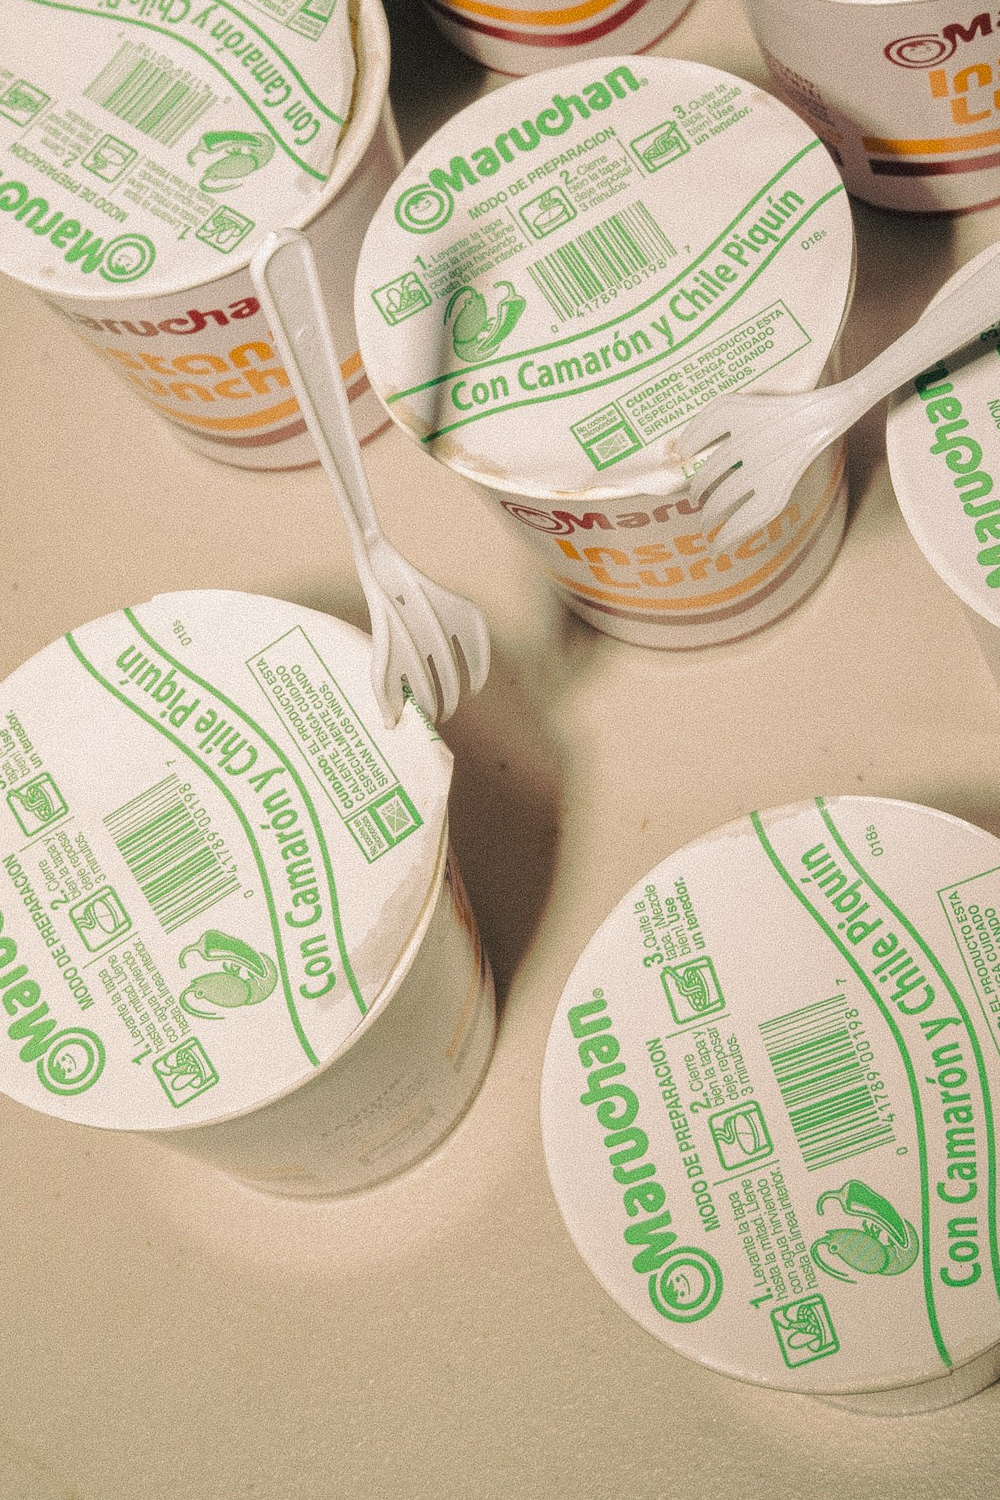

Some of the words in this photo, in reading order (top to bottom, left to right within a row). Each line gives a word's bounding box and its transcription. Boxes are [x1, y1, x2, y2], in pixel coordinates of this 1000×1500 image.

[190, 1, 221, 30] y
[210, 17, 292, 107] Camarón
[281, 100, 324, 149] Con
[429, 67, 640, 202] Maruchan
[467, 189, 509, 220] MODO
[506, 177, 529, 197] DE
[526, 125, 617, 184] PREPARACION
[0, 181, 103, 274] Maruc
[71, 296, 261, 337] arucha
[450, 376, 511, 412] Con
[517, 330, 652, 393] Camarón
[649, 315, 675, 348] y
[668, 264, 737, 322] Chile
[721, 191, 805, 267] Piquín
[127, 366, 292, 402] unch
[118, 647, 201, 728] Piquín
[194, 708, 259, 777] Chile
[247, 765, 288, 794] y
[261, 789, 323, 929] Camarón
[0, 853, 60, 948] PREPARACION
[663, 895, 681, 924] Use
[672, 876, 700, 931] tenedor.
[800, 843, 882, 944] Piquín
[947, 890, 968, 924] ESTA
[674, 928, 692, 955] bien!
[690, 930, 706, 950] un
[967, 903, 998, 963] CUIDADO
[49, 943, 73, 969] DE
[298, 933, 338, 1001] Con
[871, 932, 935, 1015] Chile
[960, 923, 995, 994] PRODUCTO
[61, 964, 95, 1011] MODO
[693, 1029, 705, 1039] y
[842, 1006, 874, 1064] 00198
[918, 1015, 963, 1040] y
[694, 1038, 712, 1066] tapa
[706, 1026, 729, 1072] reposar
[726, 1034, 748, 1084] minutos.
[683, 1053, 703, 1092] Cierre
[704, 1065, 716, 1079] la
[722, 1074, 740, 1101] deje
[740, 1085, 753, 1096] 3
[644, 1036, 694, 1152] PREPARACION
[687, 1090, 712, 1114] 2.
[709, 1080, 725, 1107] bien
[866, 1070, 895, 1127] 41789
[568, 999, 686, 1272] Maruchan
[925, 1042, 978, 1204] Camarón
[681, 1152, 704, 1179] DE
[689, 1178, 721, 1232] MODO
[728, 1190, 746, 1221] tapa
[740, 1177, 760, 1213] Llene
[756, 1177, 780, 1236] hirviendo
[769, 1169, 791, 1209] interior.
[737, 1220, 750, 1234] la
[750, 1215, 770, 1251] mitad.
[742, 1235, 768, 1288] Levante
[763, 1250, 776, 1265] la
[776, 1235, 795, 1268] agua
[793, 1240, 805, 1255] la
[938, 1215, 982, 1288] Con
[769, 1264, 786, 1301] hasta
[786, 1272, 802, 1292] con
[798, 1255, 817, 1290] hasta
[747, 1286, 774, 1310] 1.
